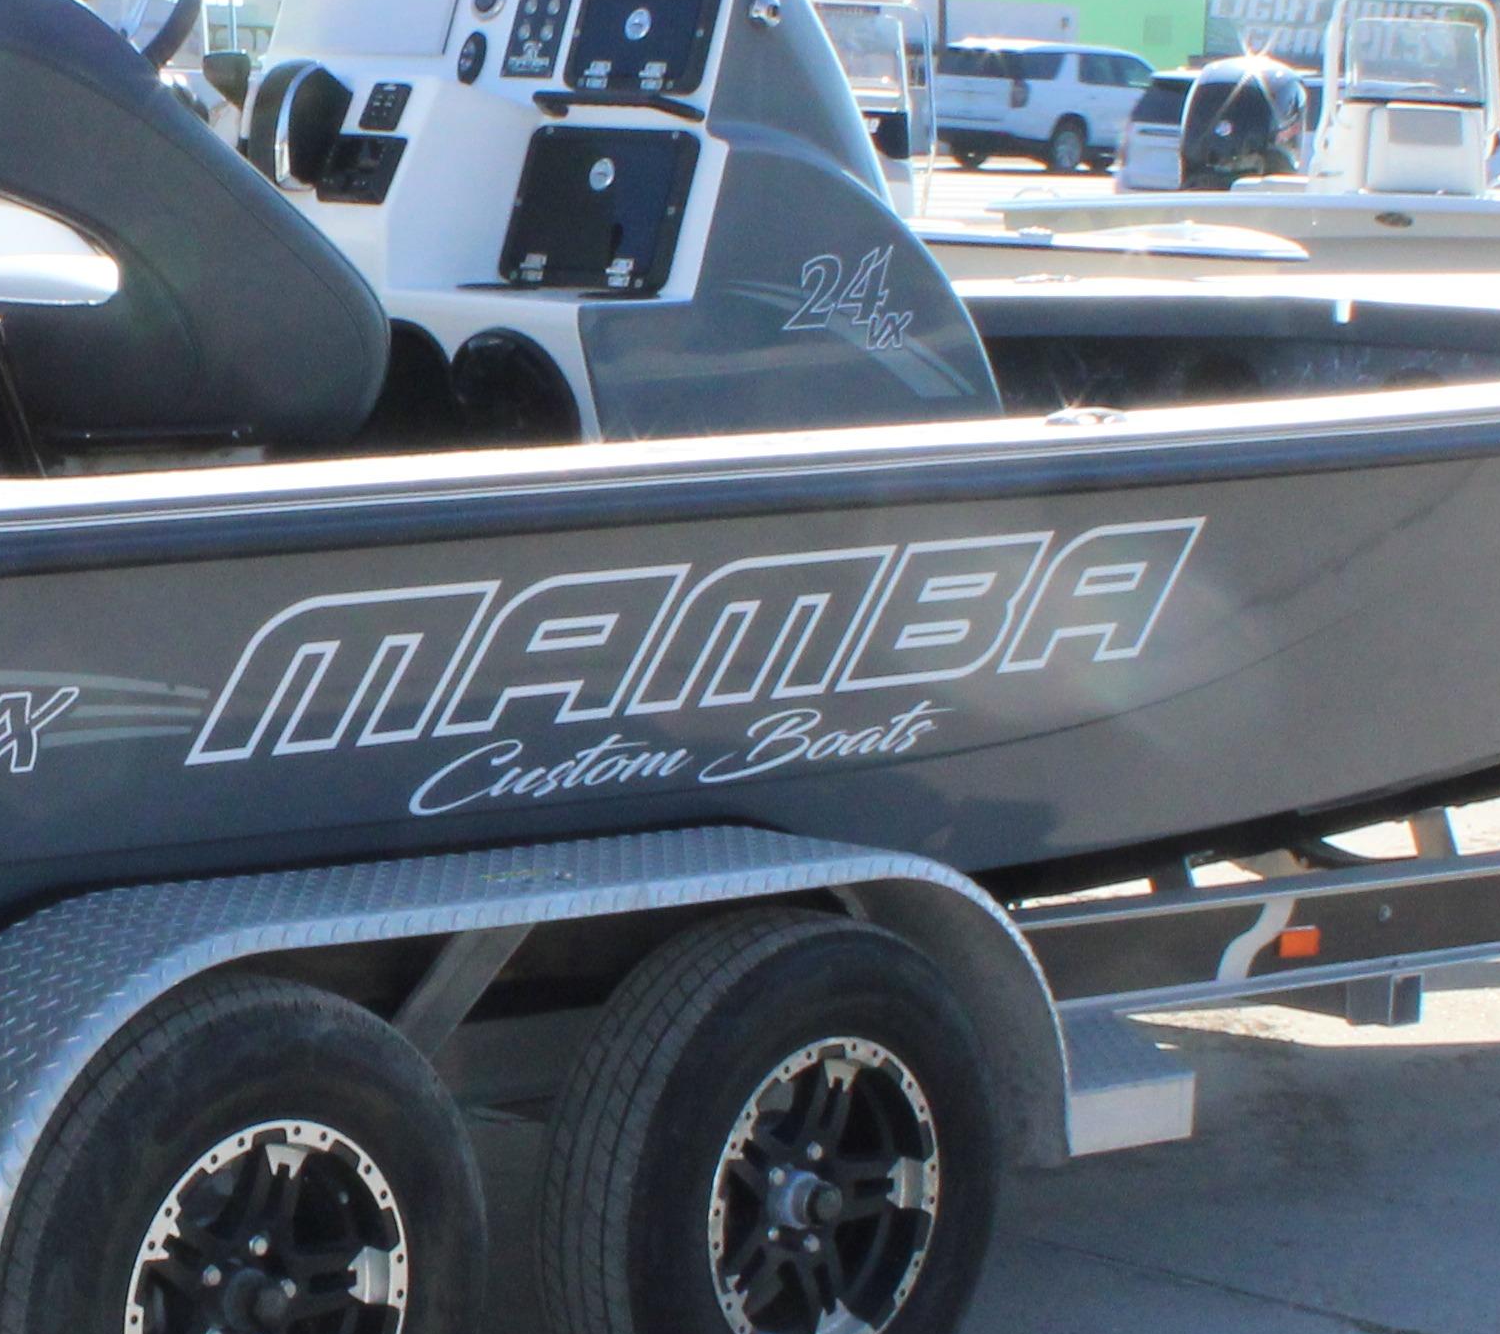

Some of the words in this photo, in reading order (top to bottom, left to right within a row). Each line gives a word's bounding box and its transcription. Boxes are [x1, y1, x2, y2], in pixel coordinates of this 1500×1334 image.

[184, 516, 1205, 765] MAMBA
[409, 732, 692, 817] Custom
[698, 700, 952, 784] Boats
